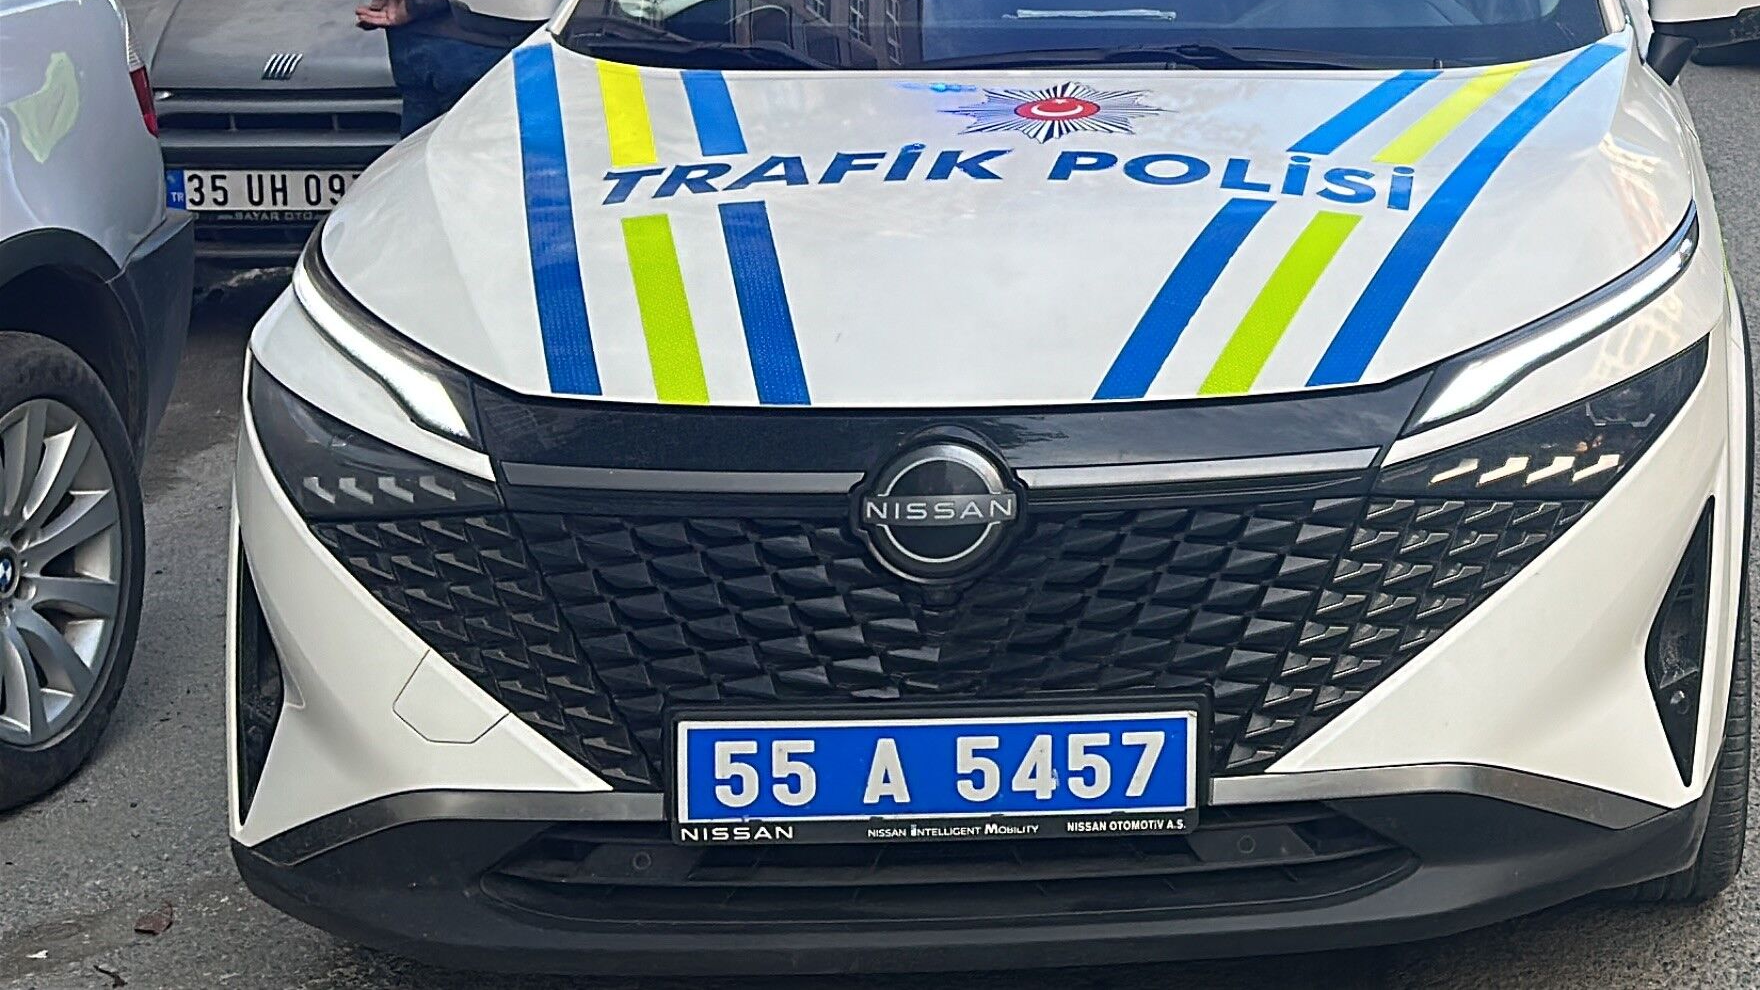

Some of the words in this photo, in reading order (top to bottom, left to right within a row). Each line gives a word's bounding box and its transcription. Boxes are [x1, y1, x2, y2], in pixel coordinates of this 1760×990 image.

[602, 142, 1013, 205] TRAFİK
[1047, 151, 1415, 211] POLİSİ
[187, 174, 229, 207] 35
[246, 174, 288, 207] UH
[304, 174, 361, 207] 09
[867, 499, 1012, 520] NISSAN
[714, 740, 816, 807] 55
[863, 738, 911, 803] A
[956, 731, 1166, 803] 5457
[681, 826, 794, 842] NISSAN
[868, 827, 906, 837] NISSAN
[1067, 821, 1107, 832] NISSAN
